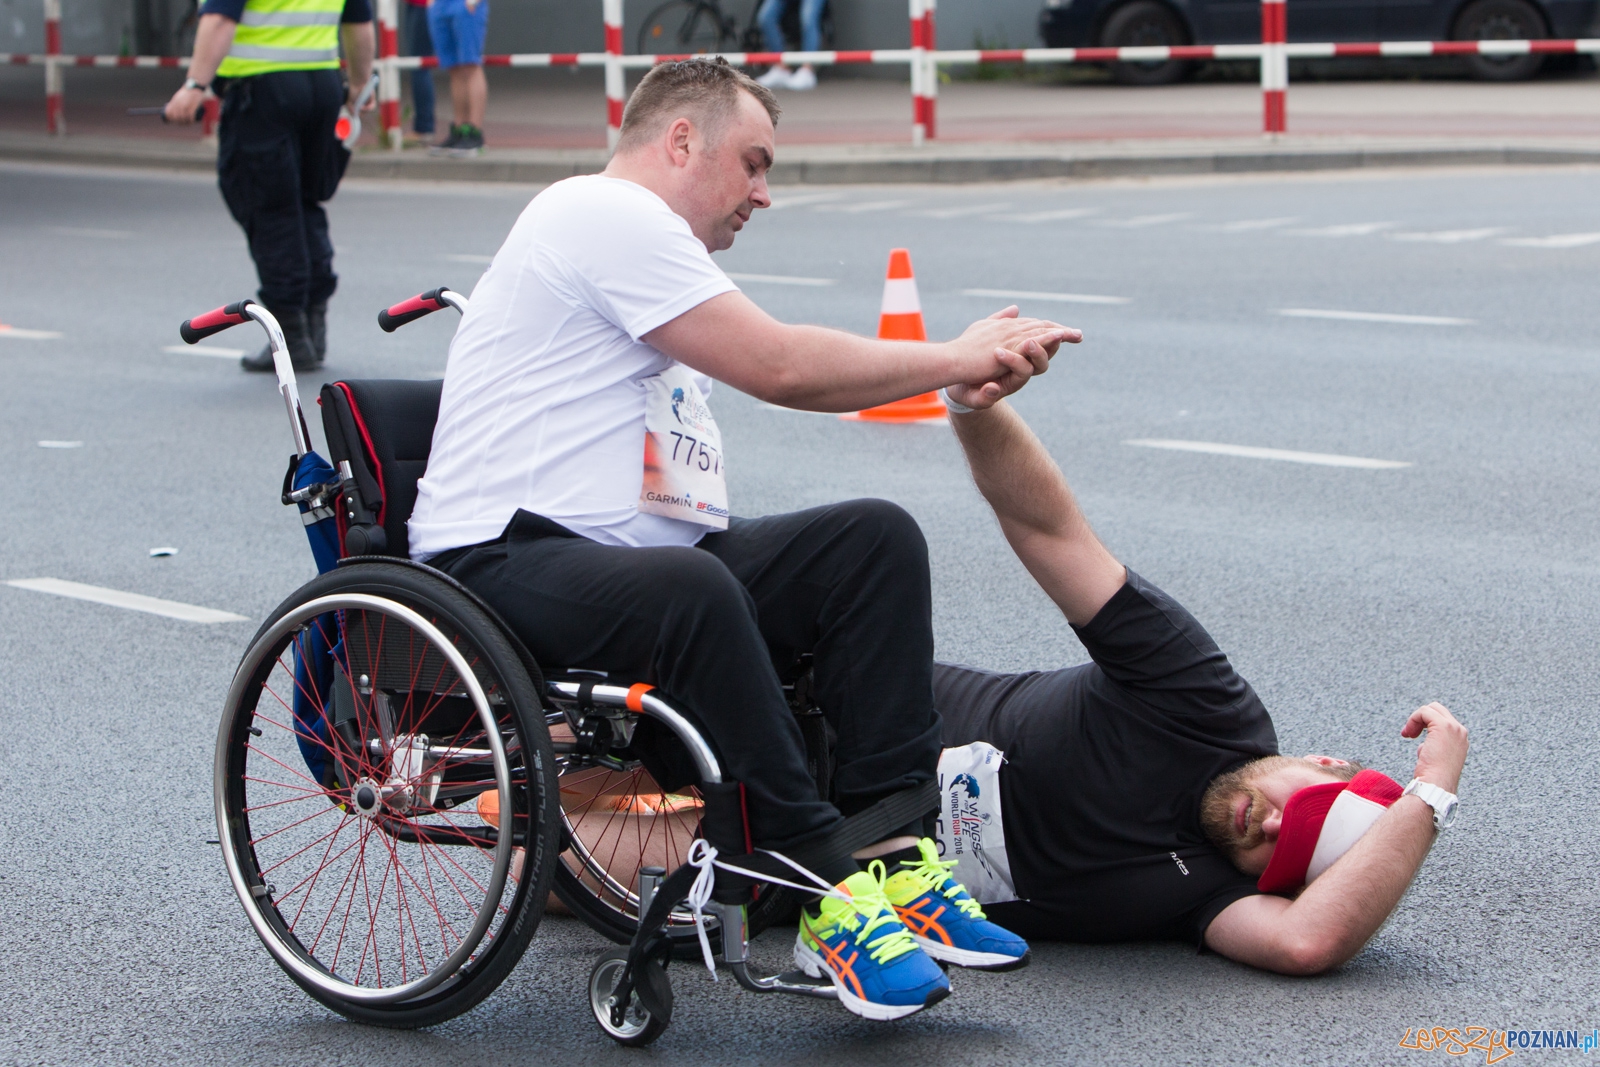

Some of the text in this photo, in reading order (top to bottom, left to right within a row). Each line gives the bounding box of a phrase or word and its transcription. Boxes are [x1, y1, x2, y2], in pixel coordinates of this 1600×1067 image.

[670, 431, 724, 475] 7757
[646, 491, 693, 508] GARMIN
[960, 809, 972, 838] LIFE
[969, 802, 983, 851] WINGS
[514, 771, 546, 936] MARATHON PLUS
[954, 837, 963, 855] 2016
